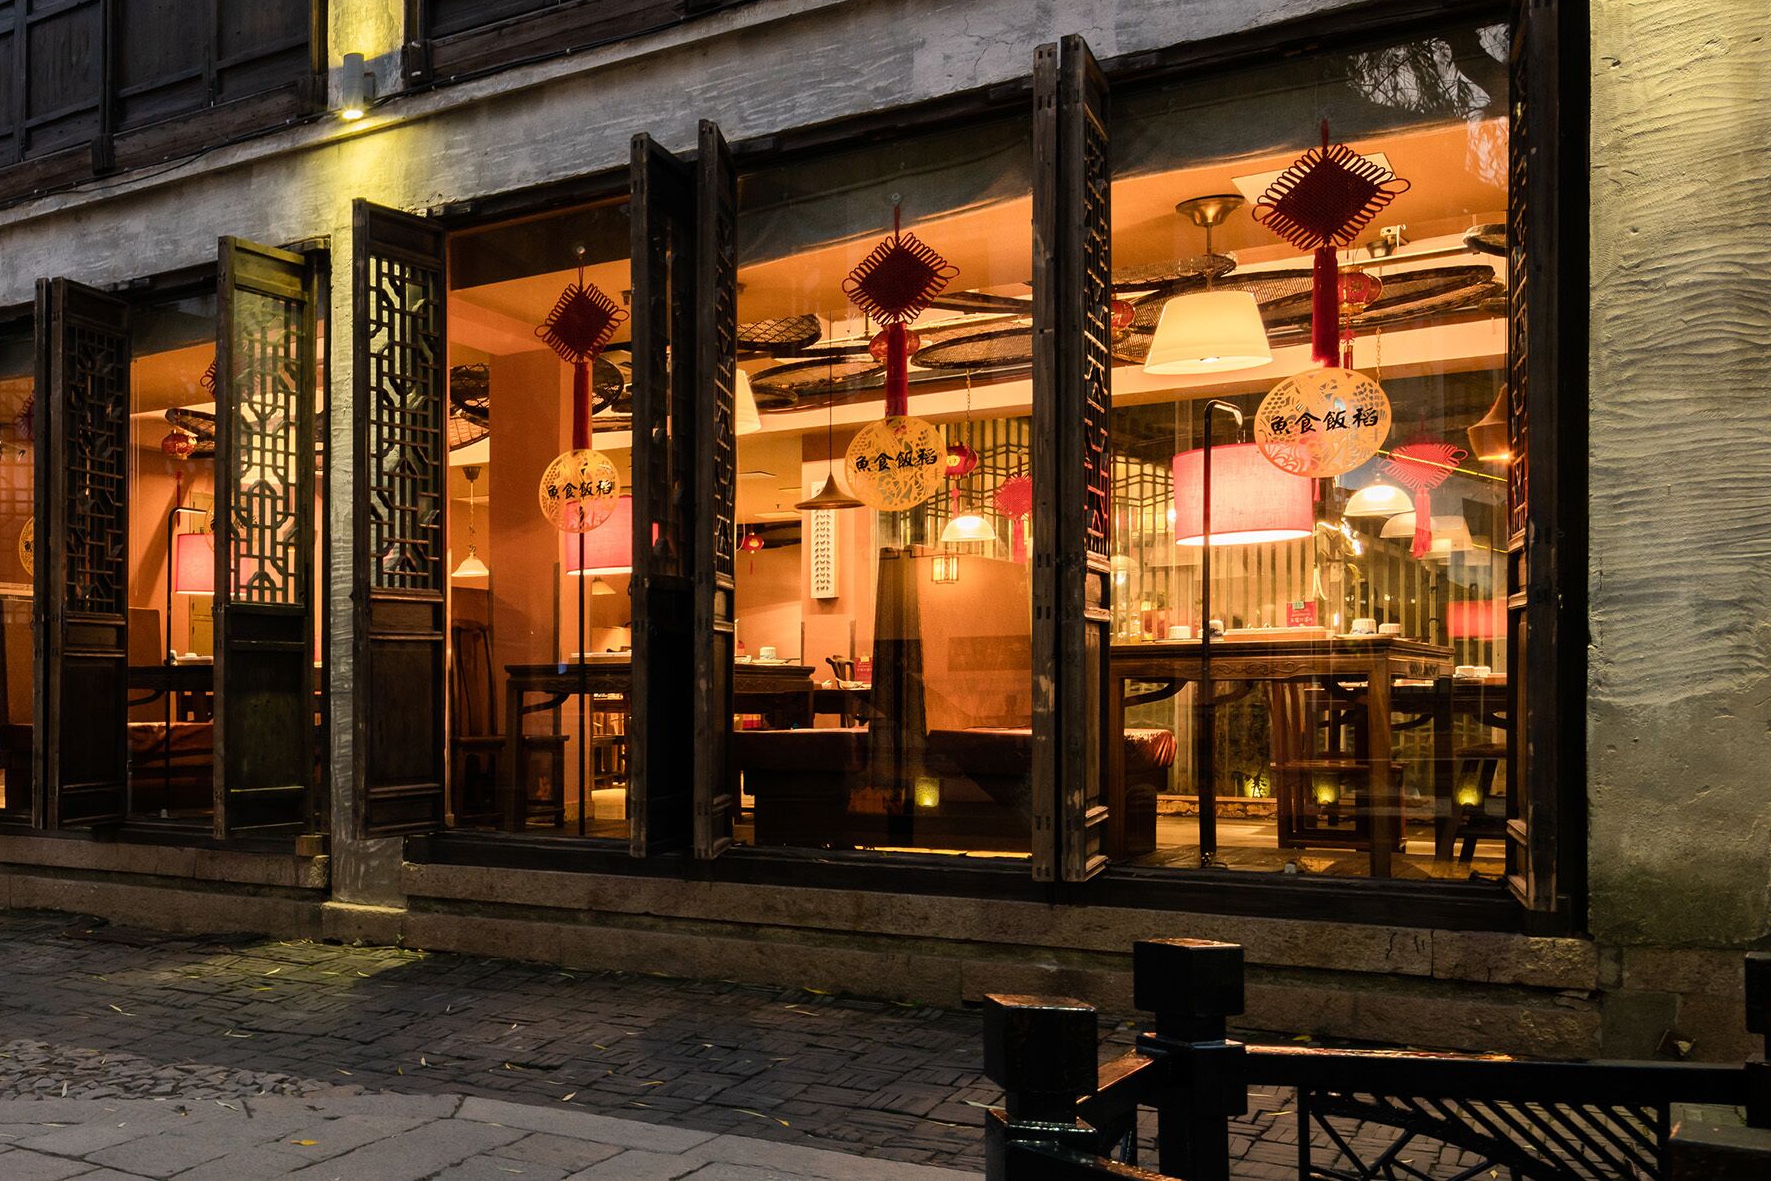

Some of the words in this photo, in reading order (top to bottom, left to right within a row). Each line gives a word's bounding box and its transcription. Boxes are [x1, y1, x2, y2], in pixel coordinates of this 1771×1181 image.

[1269, 406, 1379, 436] 魚食飯稻
[854, 448, 938, 473] 魚食飯稻
